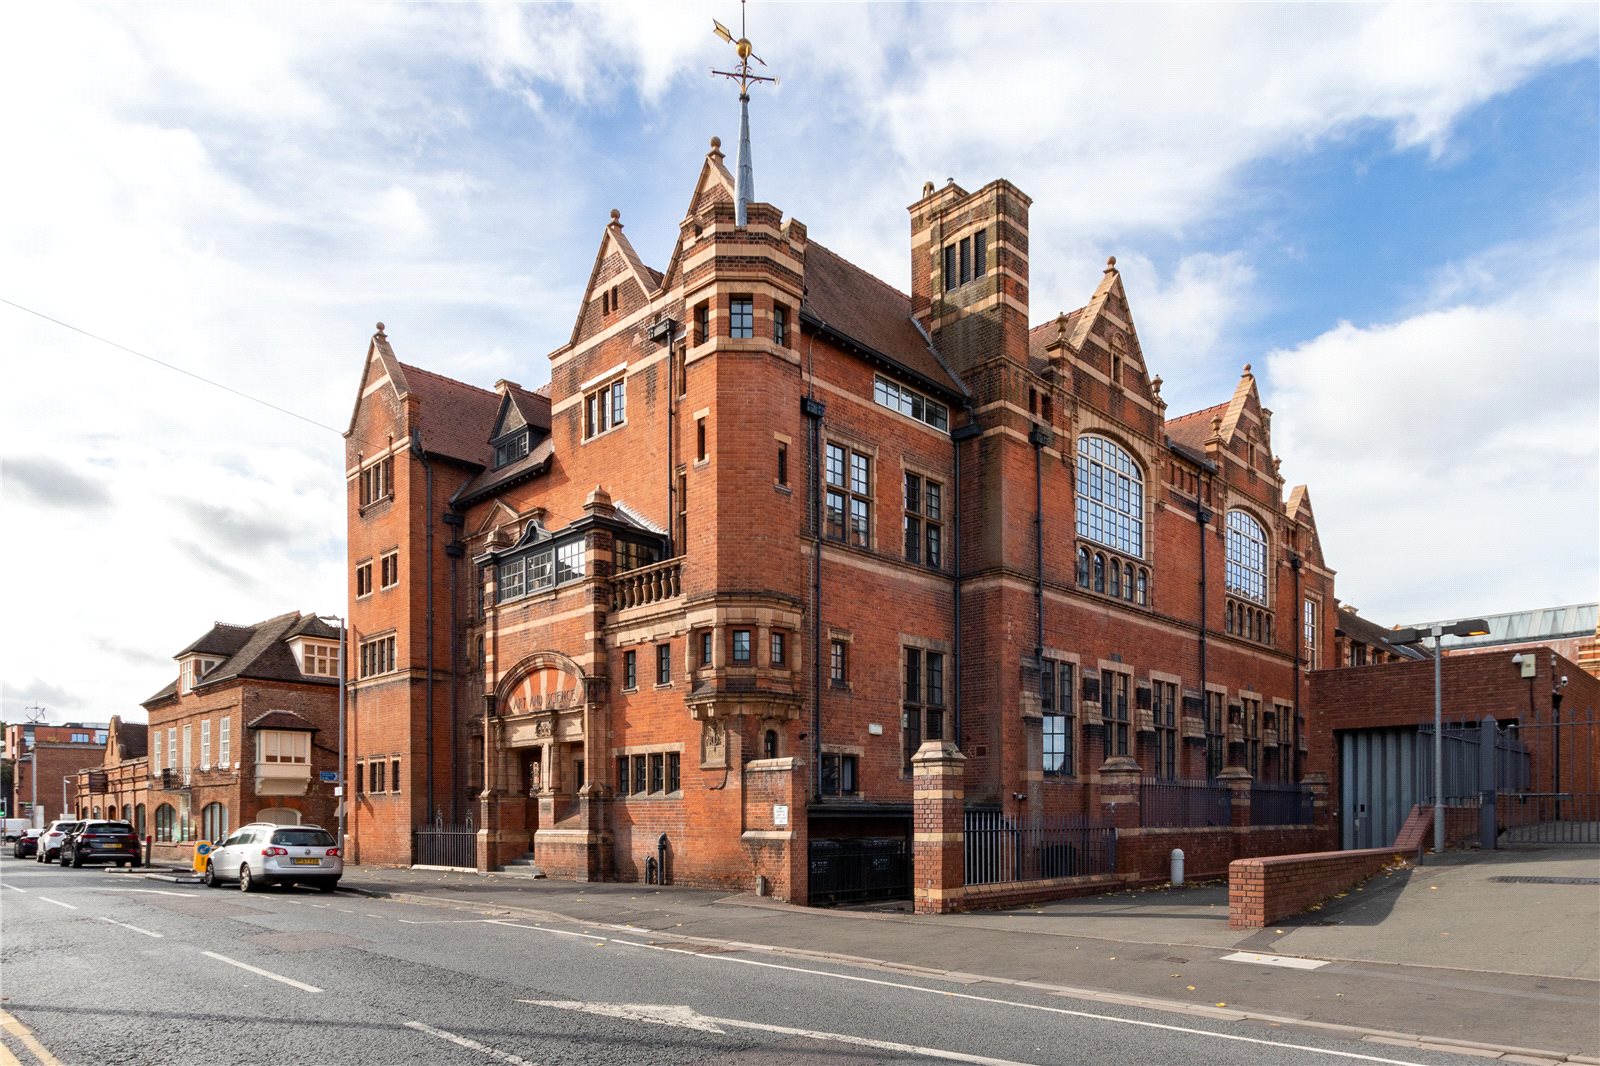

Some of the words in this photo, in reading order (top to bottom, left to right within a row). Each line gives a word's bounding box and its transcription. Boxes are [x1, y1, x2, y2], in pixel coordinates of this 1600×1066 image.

[513, 697, 526, 710] ART
[530, 694, 543, 707] AND
[546, 688, 576, 705] SCIENCE
